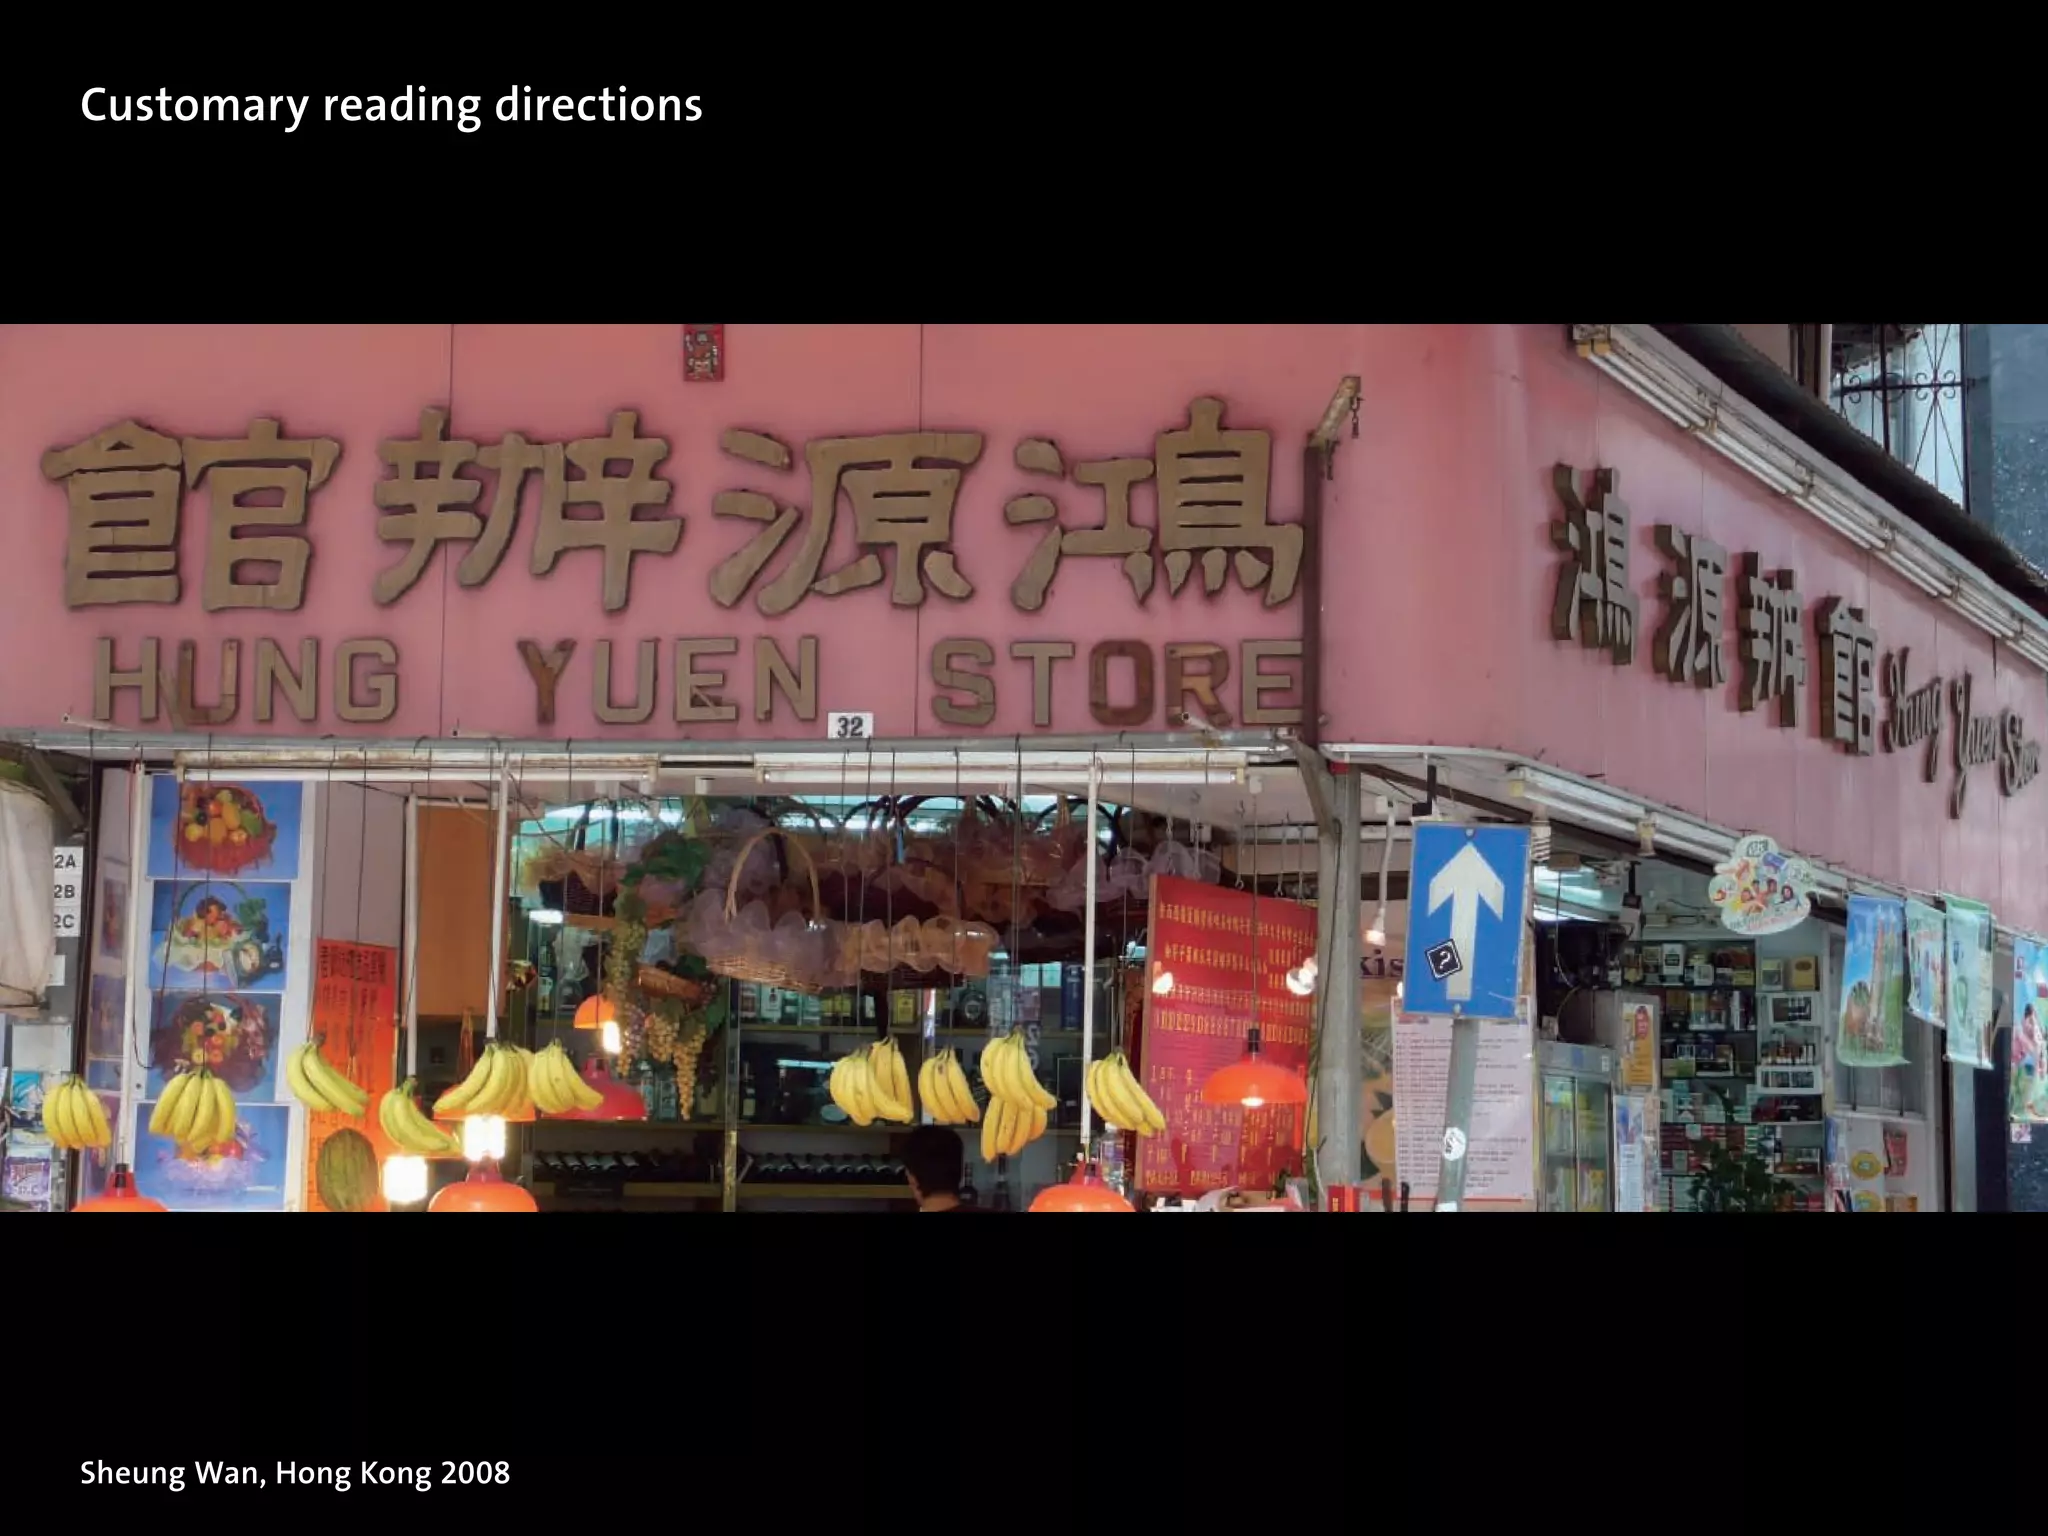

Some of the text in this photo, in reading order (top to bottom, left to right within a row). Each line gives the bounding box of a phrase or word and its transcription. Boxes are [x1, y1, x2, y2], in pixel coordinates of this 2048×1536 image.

[93, 636, 1303, 728] HUNG YUEN STORE
[838, 716, 863, 737] 32
[1881, 646, 1942, 782] Hung
